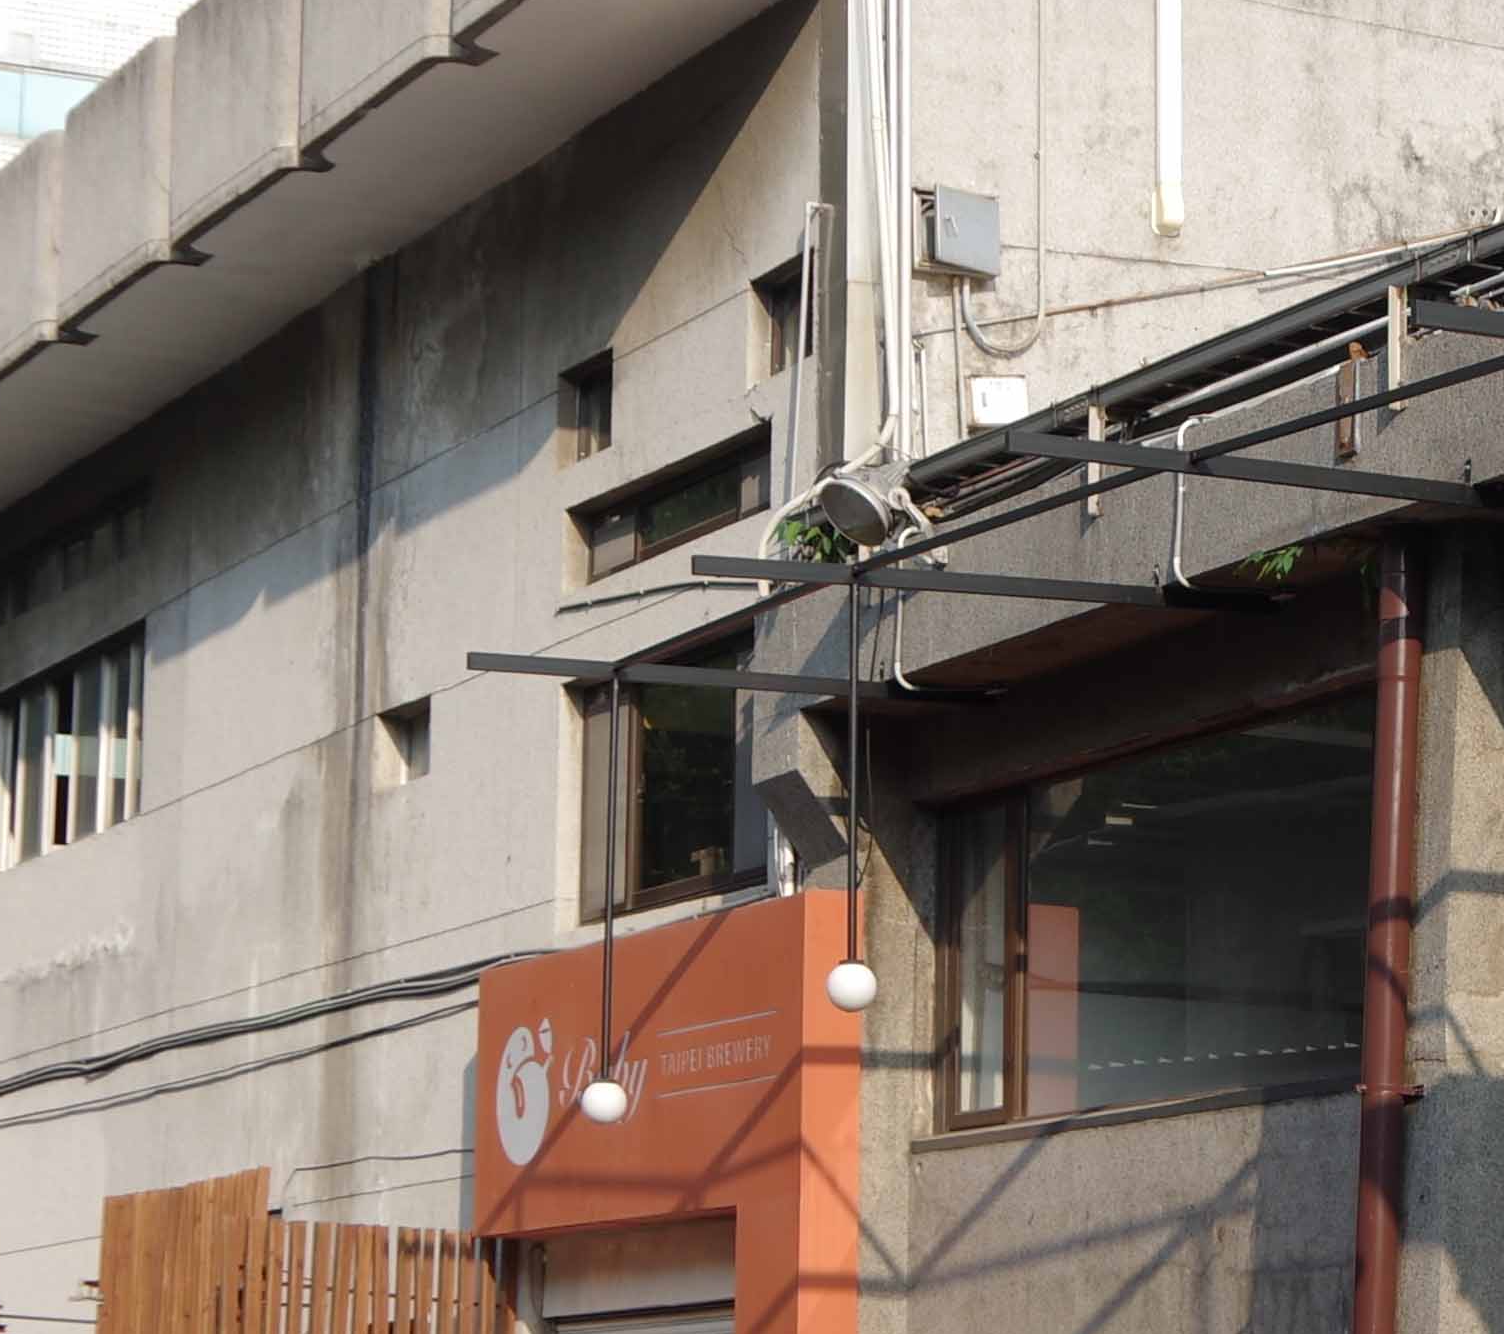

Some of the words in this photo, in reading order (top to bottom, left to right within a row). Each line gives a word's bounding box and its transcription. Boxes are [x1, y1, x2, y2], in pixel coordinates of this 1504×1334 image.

[559, 1029, 648, 1124] Bby
[659, 1046, 703, 1076] TAIPEI
[706, 1034, 773, 1069] BREWERY
